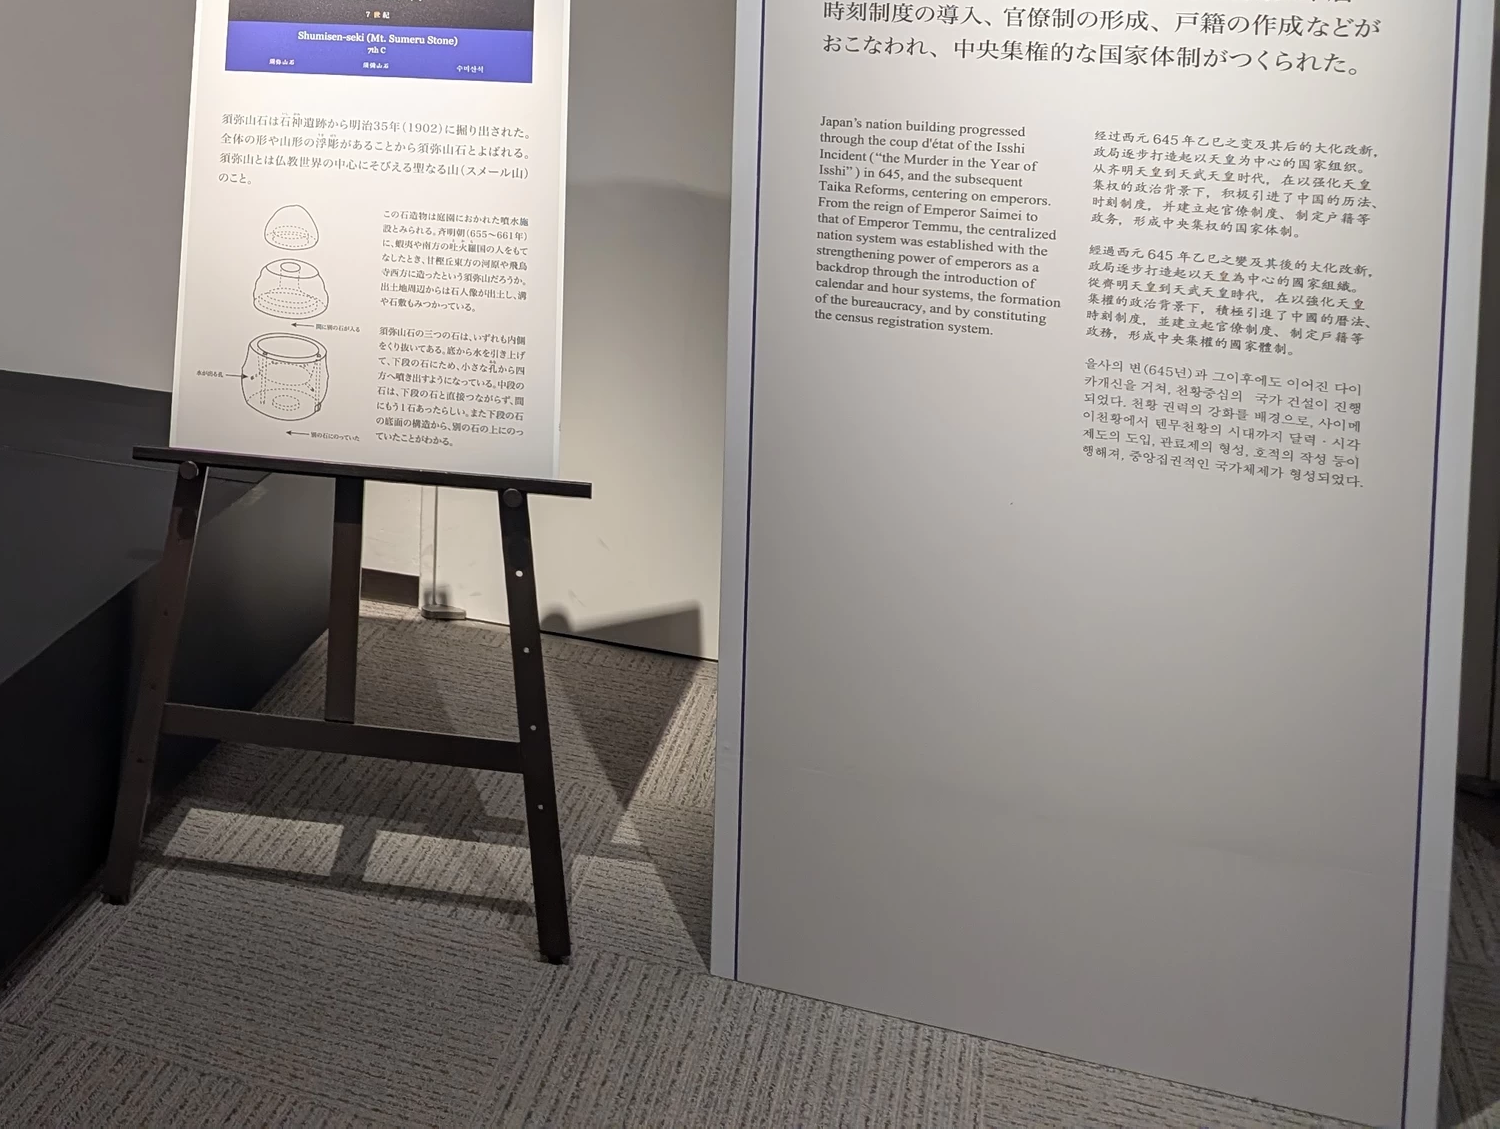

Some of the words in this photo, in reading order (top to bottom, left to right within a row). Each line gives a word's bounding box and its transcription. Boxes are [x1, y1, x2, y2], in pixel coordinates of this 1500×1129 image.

[298, 30, 364, 42] Shumisen-seki
[367, 32, 387, 43] (Mt.
[389, 33, 425, 44] Sumeru
[427, 35, 458, 47] Stone)
[367, 45, 379, 54] 7th
[380, 46, 387, 54] C
[866, 118, 902, 131] nation
[906, 119, 956, 136] building
[959, 125, 1026, 138] progressed
[820, 131, 865, 147] through
[868, 134, 886, 146] the
[889, 138, 919, 151] coup
[957, 139, 973, 151] of
[974, 140, 993, 152] the
[996, 141, 1025, 154] Isshi
[820, 148, 867, 162] Incident
[904, 153, 949, 166] Murder
[952, 155, 964, 168] in
[968, 156, 986, 169] the
[990, 158, 1021, 171] Year
[1023, 160, 1039, 172] of
[864, 166, 875, 178] in
[878, 167, 904, 182] 645,
[907, 170, 929, 182] and
[933, 171, 952, 183] the
[955, 172, 1023, 189] subsequent
[818, 179, 851, 193] Taika
[855, 182, 908, 199] Reforms,
[912, 188, 968, 203] centering
[971, 192, 987, 202] on
[990, 193, 1051, 206] emperors.
[818, 196, 849, 209] From
[852, 198, 871, 210] the
[873, 200, 904, 215] reign
[907, 202, 922, 214] of
[923, 203, 977, 219] Emperor
[980, 207, 1022, 221] Saimei
[1026, 211, 1038, 222] to
[818, 212, 839, 224] that
[842, 214, 857, 225] of
[858, 215, 910, 230] Emperor
[912, 219, 963, 235] Temmu,
[966, 222, 985, 235] the
[989, 226, 1057, 241] centralized
[817, 229, 853, 242] nation
[856, 234, 897, 245] system
[900, 237, 923, 247] was
[927, 238, 994, 252] established
[998, 242, 1025, 255] with
[1029, 244, 1048, 257] the
[817, 246, 895, 264] strengthening
[898, 253, 936, 265] power
[939, 254, 954, 266] of
[955, 258, 1012, 271] emperors
[1015, 262, 1029, 272] as
[1032, 264, 1040, 273] a
[816, 260, 870, 278] backdrop
[873, 264, 918, 282] through
[922, 269, 941, 281] the
[944, 270, 1018, 288] introduction
[1022, 277, 1037, 289] of
[815, 277, 865, 291] calendar
[867, 282, 889, 293] and
[892, 282, 920, 296] hour
[922, 288, 974, 303] systems,
[977, 290, 996, 302] the
[1000, 291, 1061, 308] formation
[814, 308, 832, 320] the
[835, 313, 874, 324] census
[877, 315, 944, 331] registration
[948, 323, 993, 335] system.
[815, 292, 829, 304] of
[830, 293, 849, 306] the
[851, 295, 926, 315] bureaucracy,
[929, 303, 952, 315] and
[955, 304, 971, 319] by
[974, 308, 1047, 327] constituting
